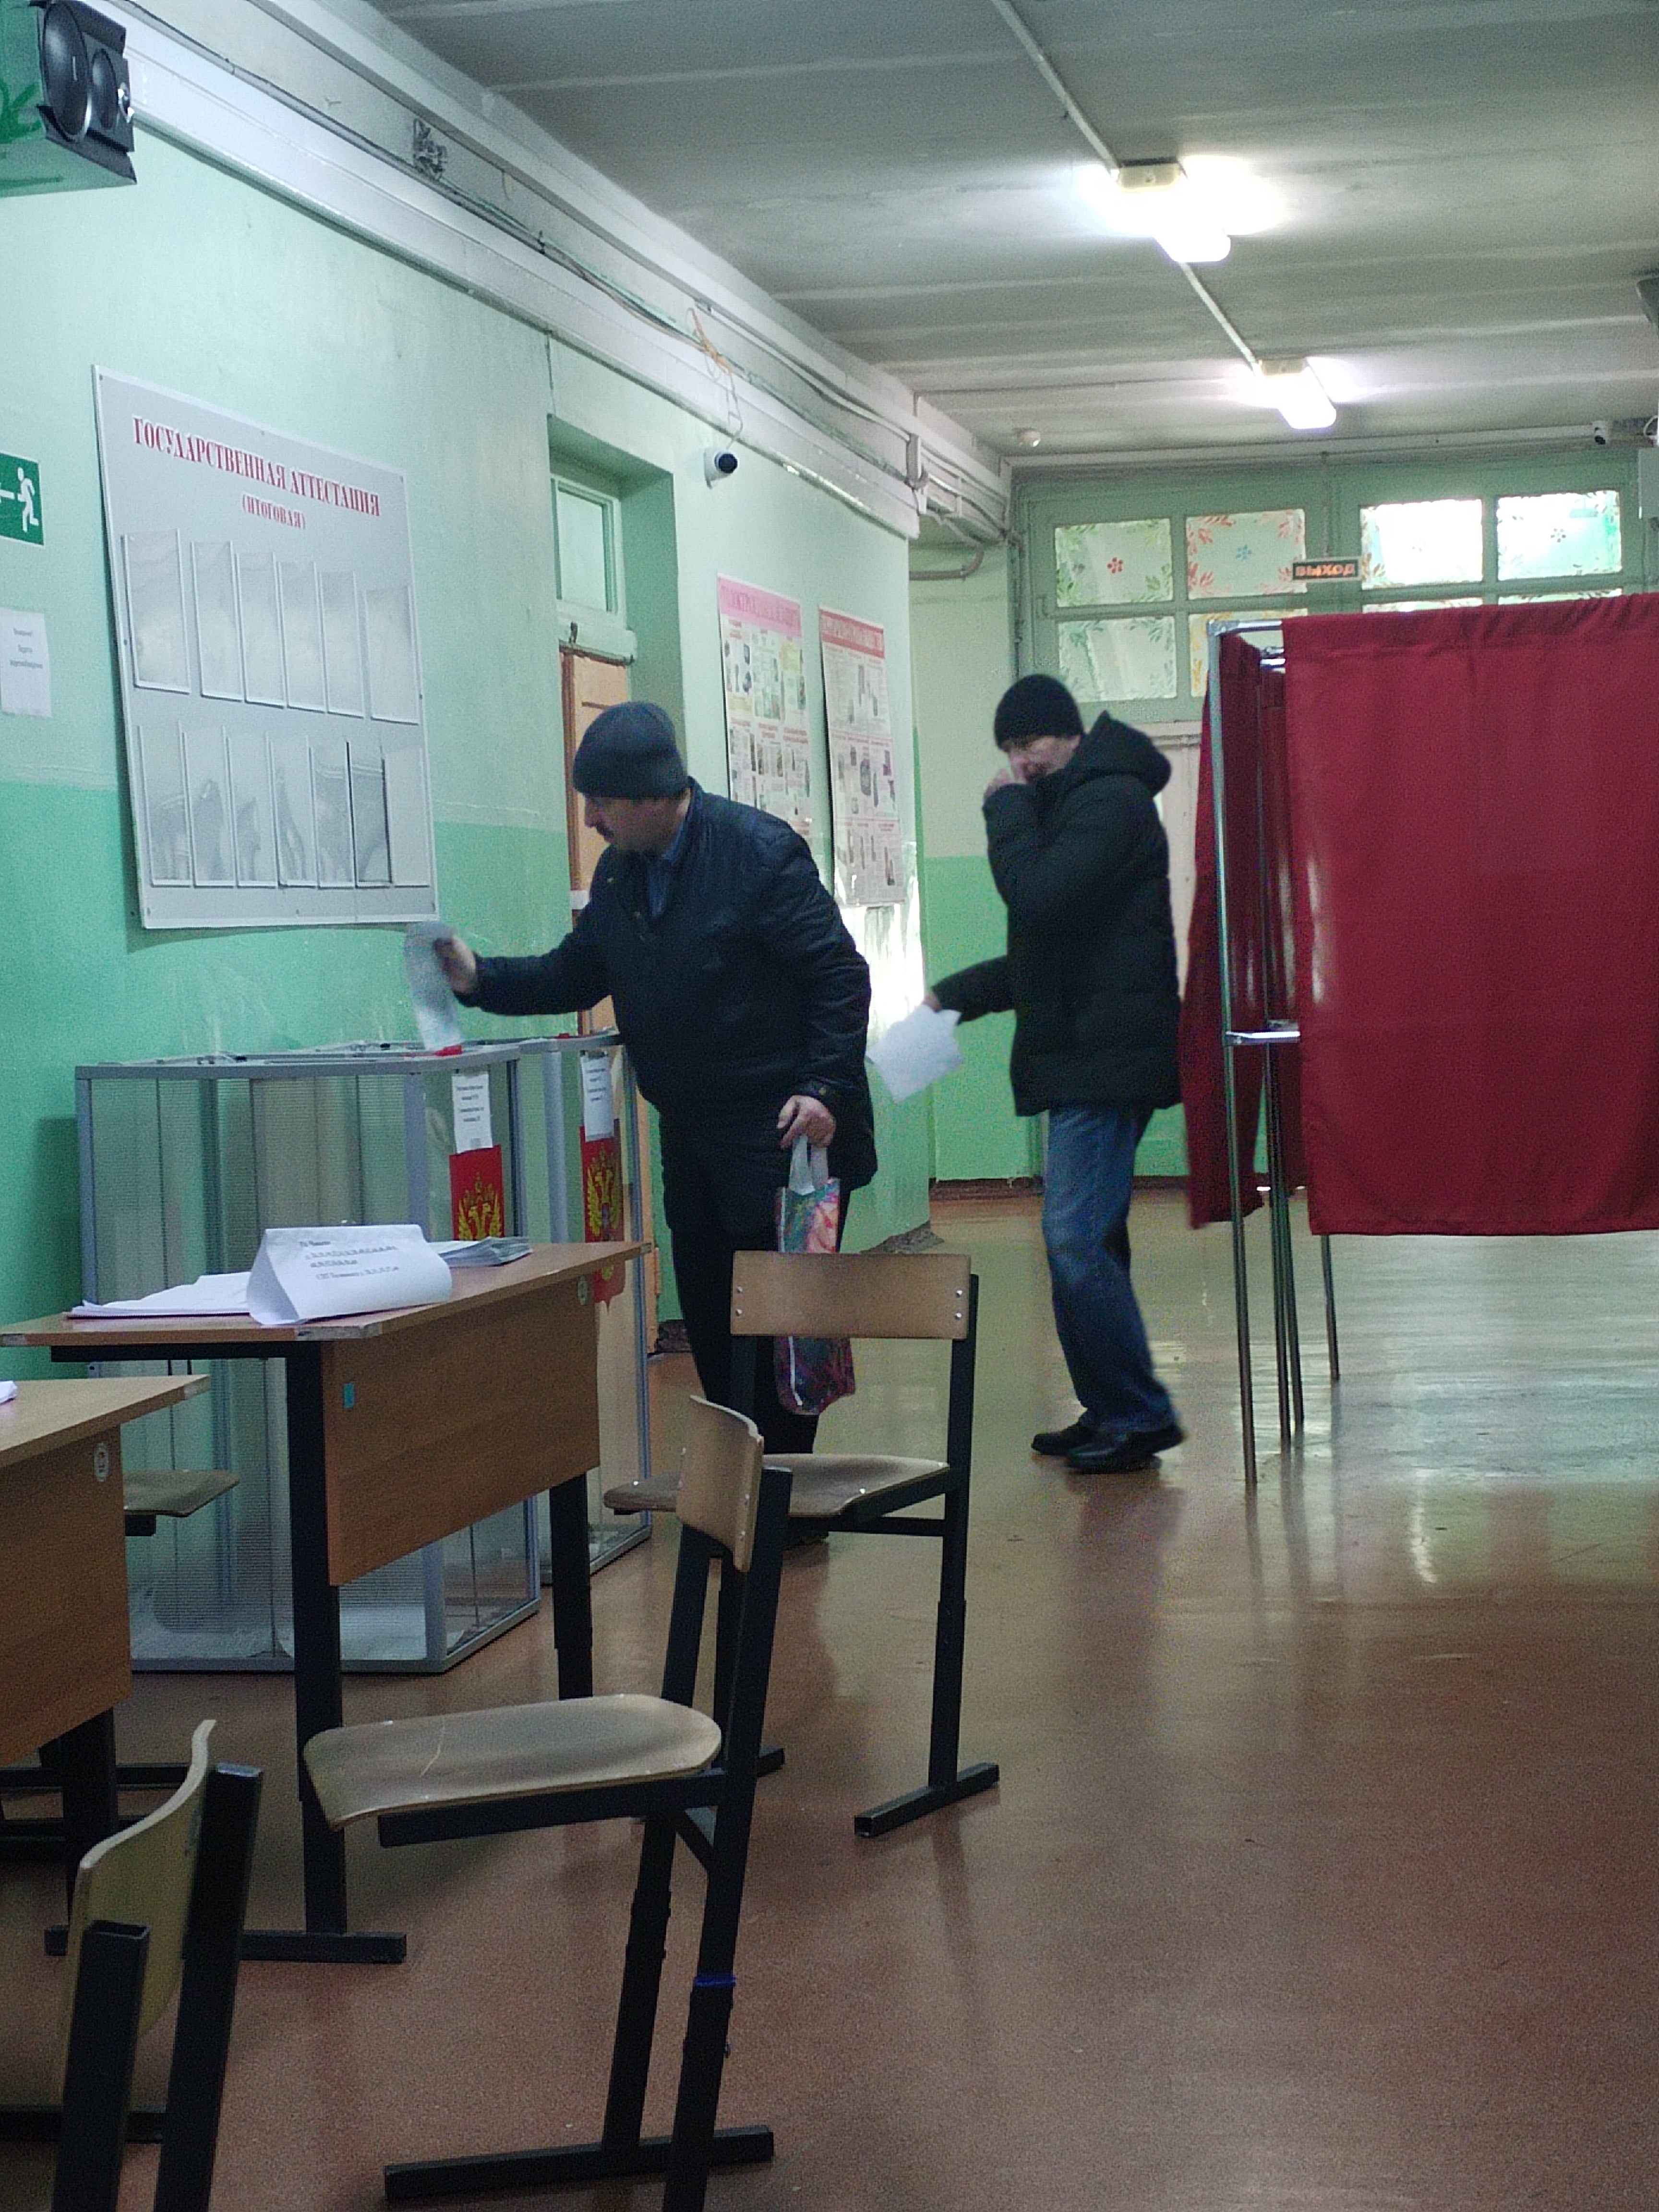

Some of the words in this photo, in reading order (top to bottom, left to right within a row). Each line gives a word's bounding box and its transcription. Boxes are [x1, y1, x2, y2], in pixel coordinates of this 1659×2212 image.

[133, 417, 287, 489] ГОСУДАРСТВЕННАЯ
[290, 470, 380, 517] АТТЕСТАЦИЯ
[242, 493, 306, 529] (ИТОГОВАЯ)
[1295, 564, 1355, 577] ВЫХОД
